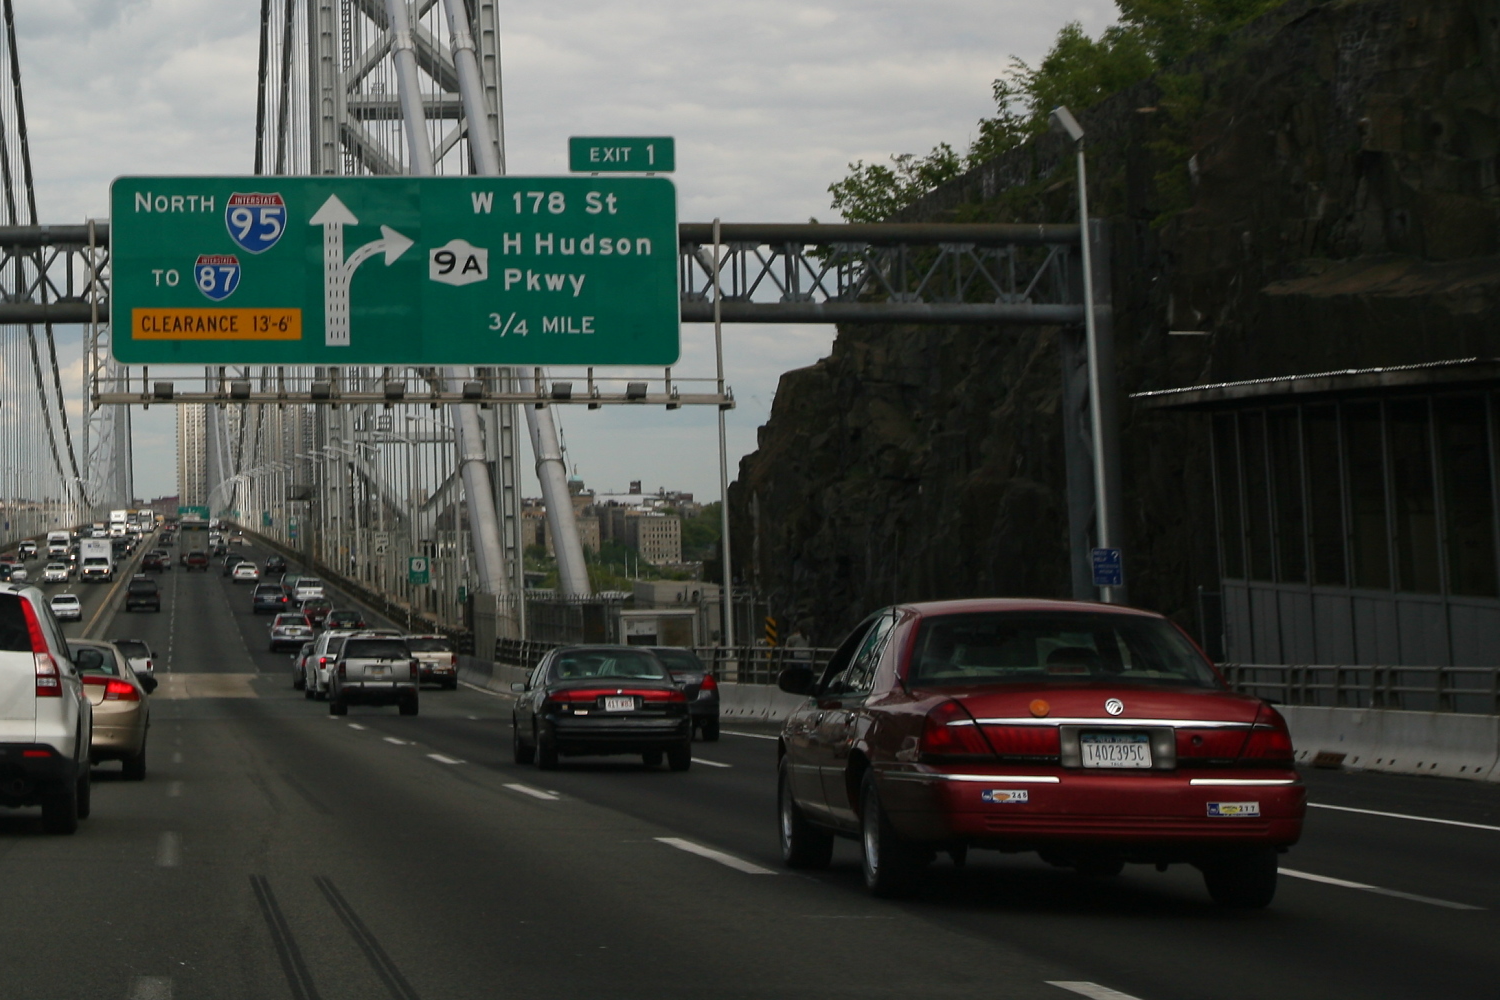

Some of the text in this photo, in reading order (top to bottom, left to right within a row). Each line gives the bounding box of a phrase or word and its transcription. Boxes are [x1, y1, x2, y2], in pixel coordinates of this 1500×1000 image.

[589, 144, 655, 165] EXIT 1
[134, 191, 215, 213] NORTH
[234, 196, 278, 205] INTERSTATE
[471, 191, 618, 214] W 178 St
[231, 207, 281, 242] 95
[502, 232, 652, 256] H Hudson
[433, 250, 483, 275] 9A
[151, 269, 180, 287] TO
[199, 266, 236, 293] 87
[503, 268, 586, 297] Pkwy
[141, 315, 239, 333] CLEARANCE
[488, 312, 595, 337] 3/4 MILE
[1086, 744, 1145, 761] T402395C
